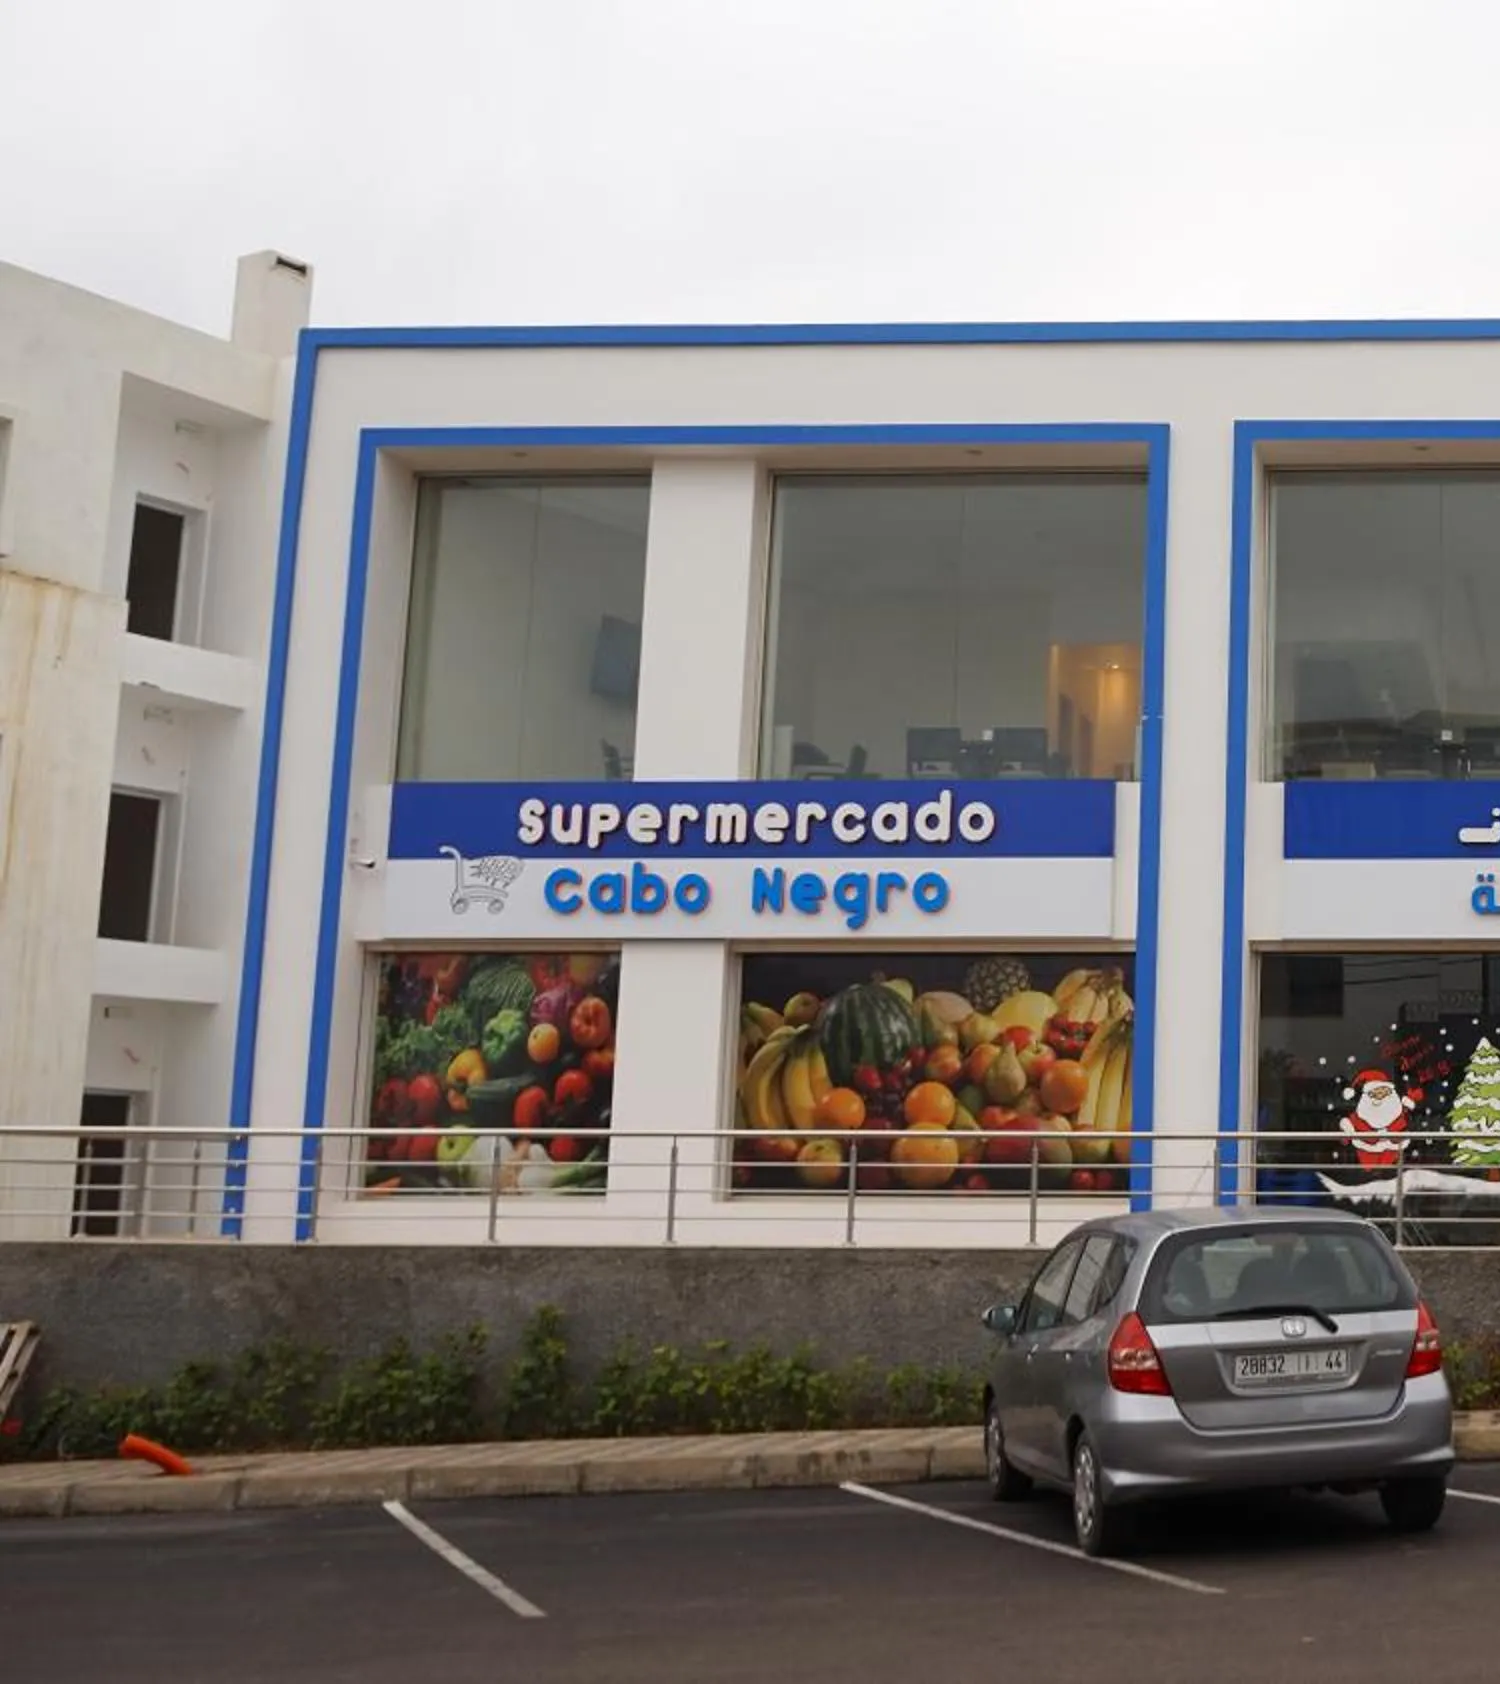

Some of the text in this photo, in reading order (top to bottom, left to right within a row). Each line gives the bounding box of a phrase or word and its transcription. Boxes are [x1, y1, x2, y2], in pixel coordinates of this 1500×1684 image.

[518, 789, 996, 849] Supermercado
[543, 863, 951, 929] Cabo Negro
[1325, 1351, 1343, 1370] 44
